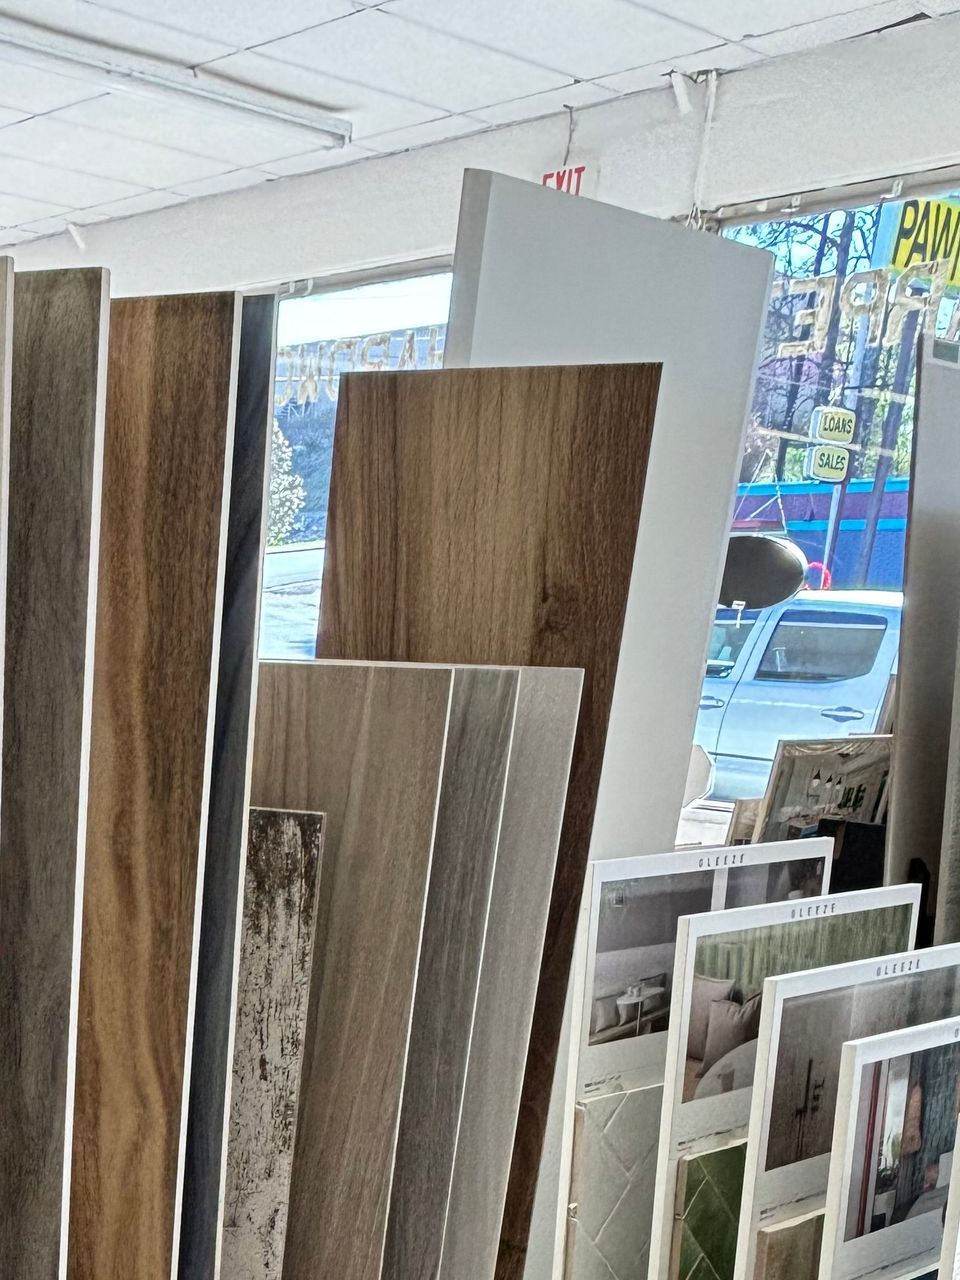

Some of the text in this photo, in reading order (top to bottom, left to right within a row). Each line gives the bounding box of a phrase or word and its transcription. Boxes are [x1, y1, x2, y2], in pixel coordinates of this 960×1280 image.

[892, 199, 960, 281] PAW
[823, 414, 853, 434] LOANS
[818, 452, 846, 472] SALES
